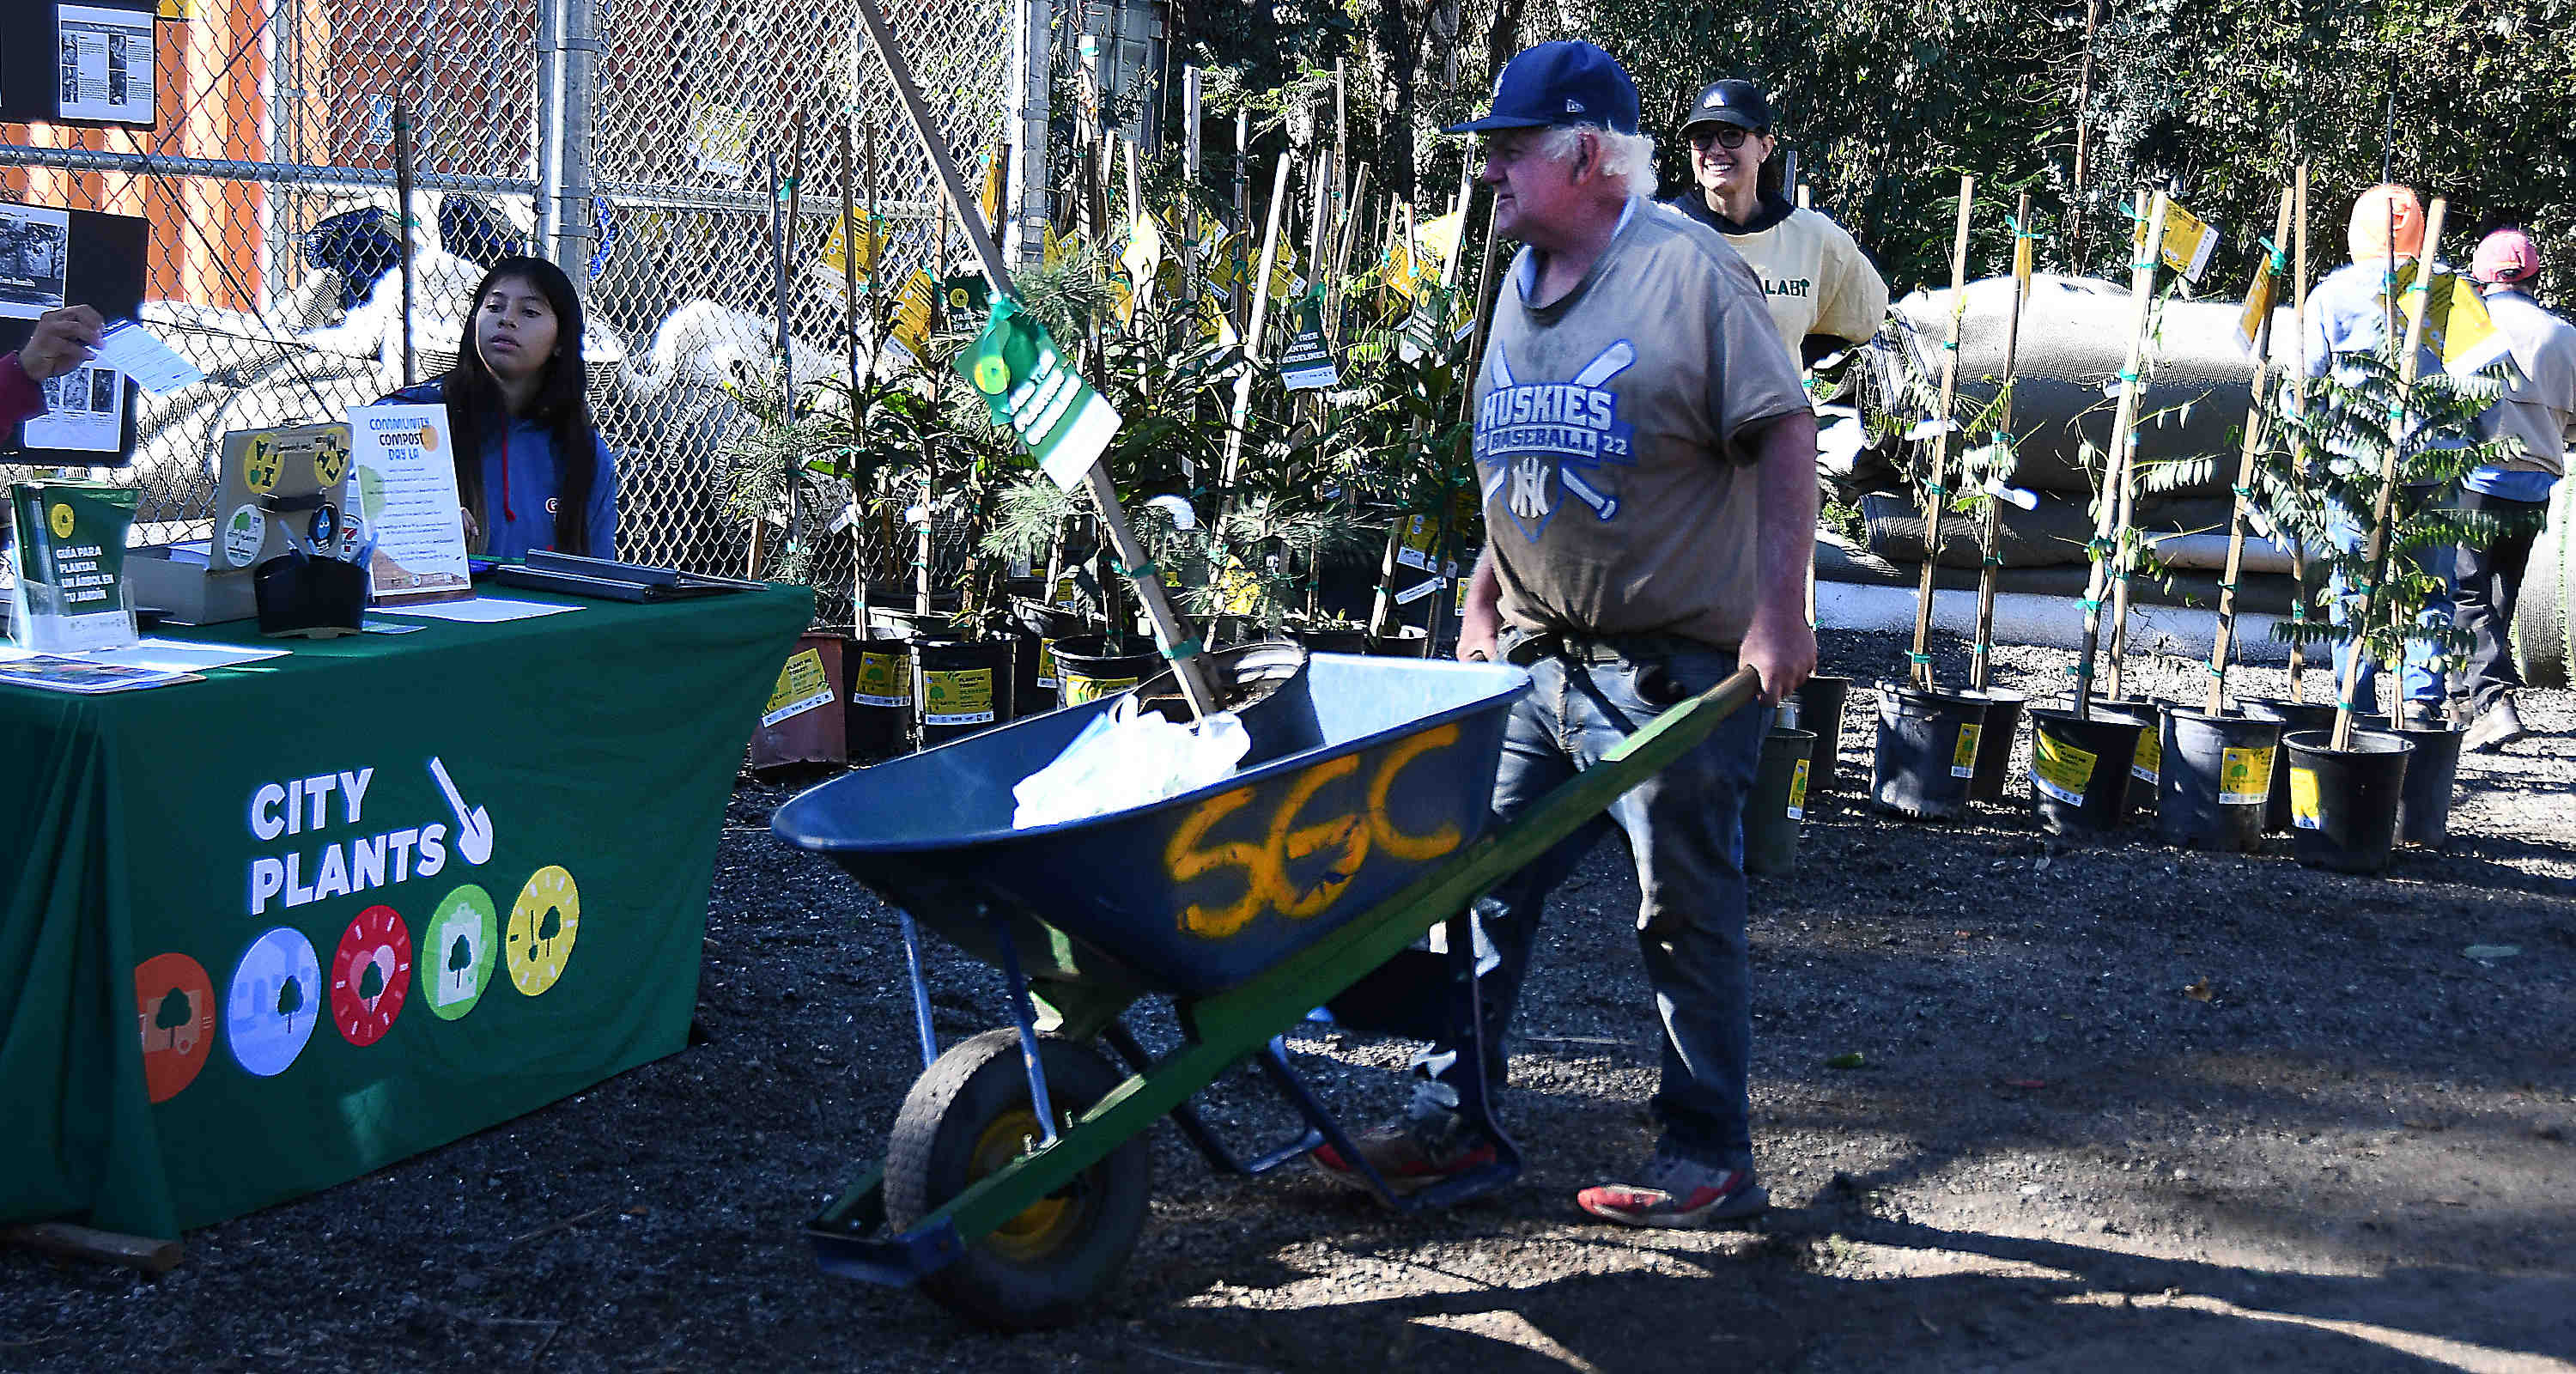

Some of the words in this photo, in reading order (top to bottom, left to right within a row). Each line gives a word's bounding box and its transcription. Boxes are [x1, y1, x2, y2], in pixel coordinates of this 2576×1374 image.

[1481, 386, 1612, 432] HUSKIES
[369, 416, 430, 430] COMMUNITY
[379, 432, 424, 446] COMPOST
[1492, 429, 1595, 452] BASEBALL
[1602, 435, 1628, 456] 22
[388, 447, 406, 461] DAY
[76, 545, 103, 557] PARA
[59, 561, 98, 574] PLANTAR
[251, 767, 374, 841] CITY
[1164, 723, 1461, 937] SGC
[251, 823, 447, 916] PLANTS
